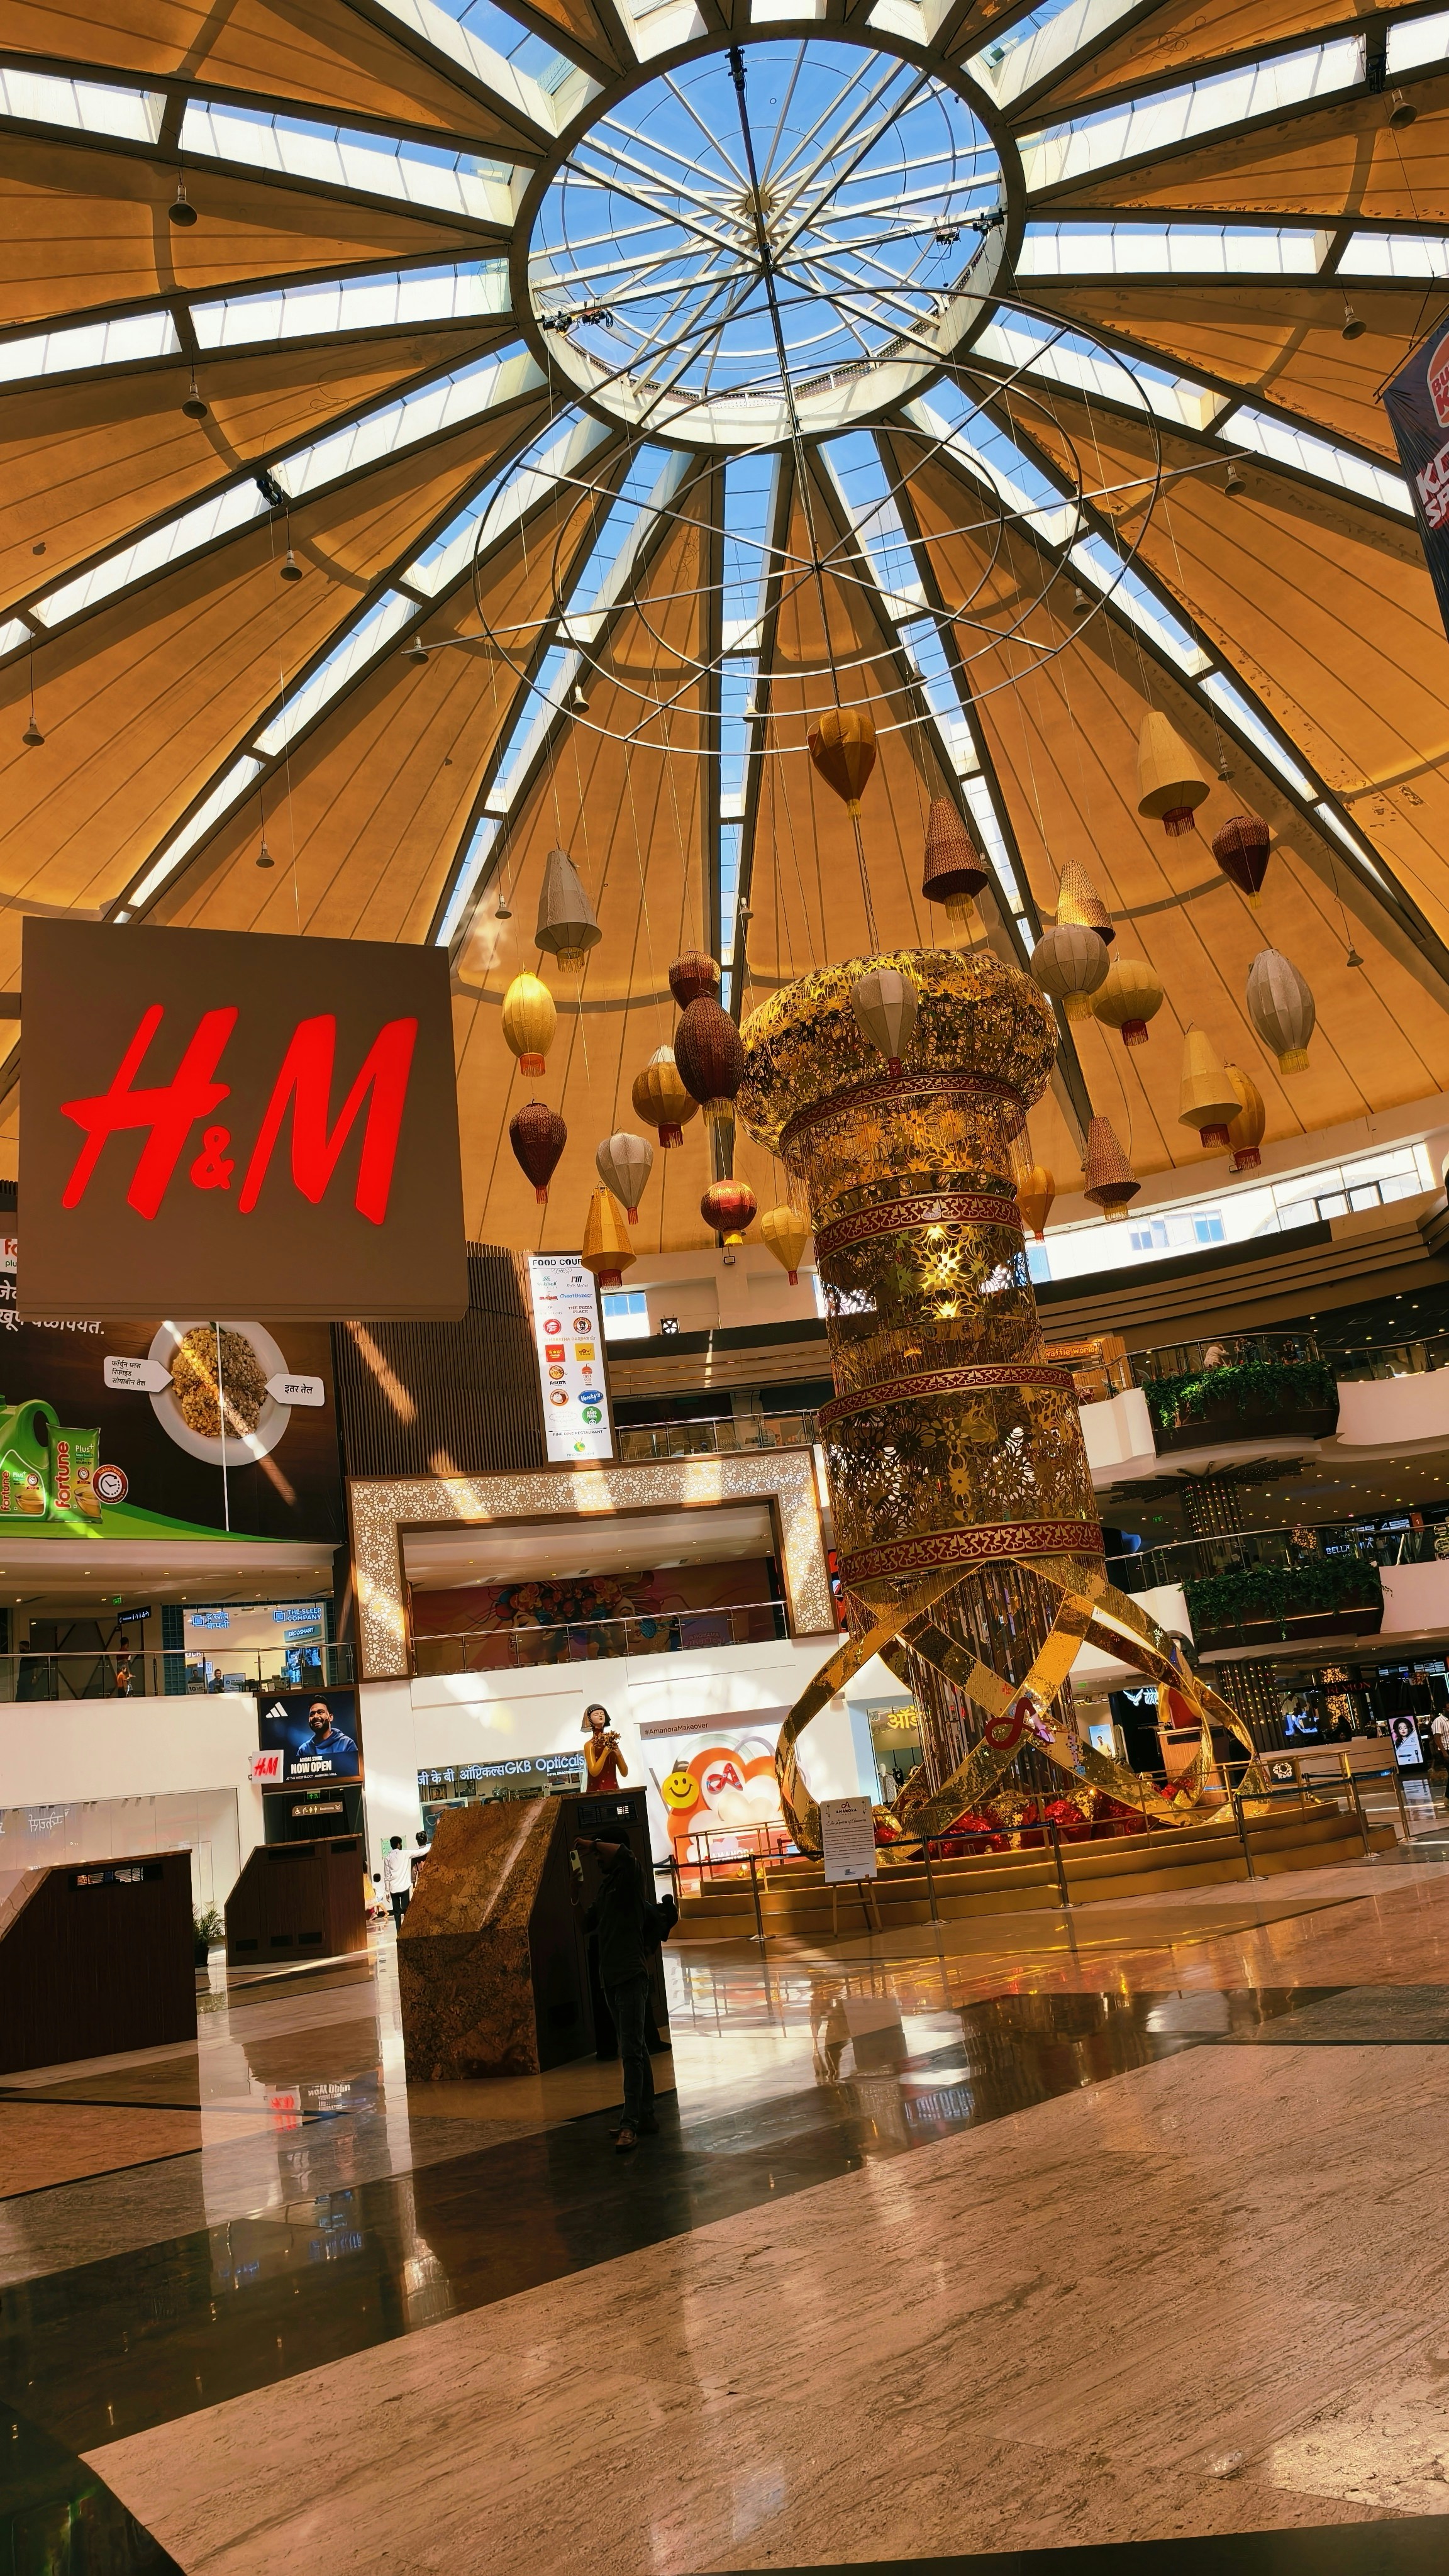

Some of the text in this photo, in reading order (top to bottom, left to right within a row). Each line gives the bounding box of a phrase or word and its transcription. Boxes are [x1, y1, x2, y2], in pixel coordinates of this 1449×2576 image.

[61, 1004, 418, 1224] H&M
[1073, 1345, 1095, 1355] world
[136, 1378, 146, 1386] तेल
[284, 1383, 313, 1394] इतर तेल
[580, 1392, 601, 1402] Venky's
[54, 1440, 71, 1509] fortune
[287, 1614, 322, 1622] COMPANY
[645, 1722, 709, 1736] #AmanoraMakeover
[254, 1757, 279, 1777] H&M
[291, 1760, 332, 1775] NOW OPEN
[505, 1760, 531, 1775] GKB
[535, 1753, 585, 1772] Opticals
[431, 1768, 442, 1784] के
[444, 1767, 455, 1782] बी
